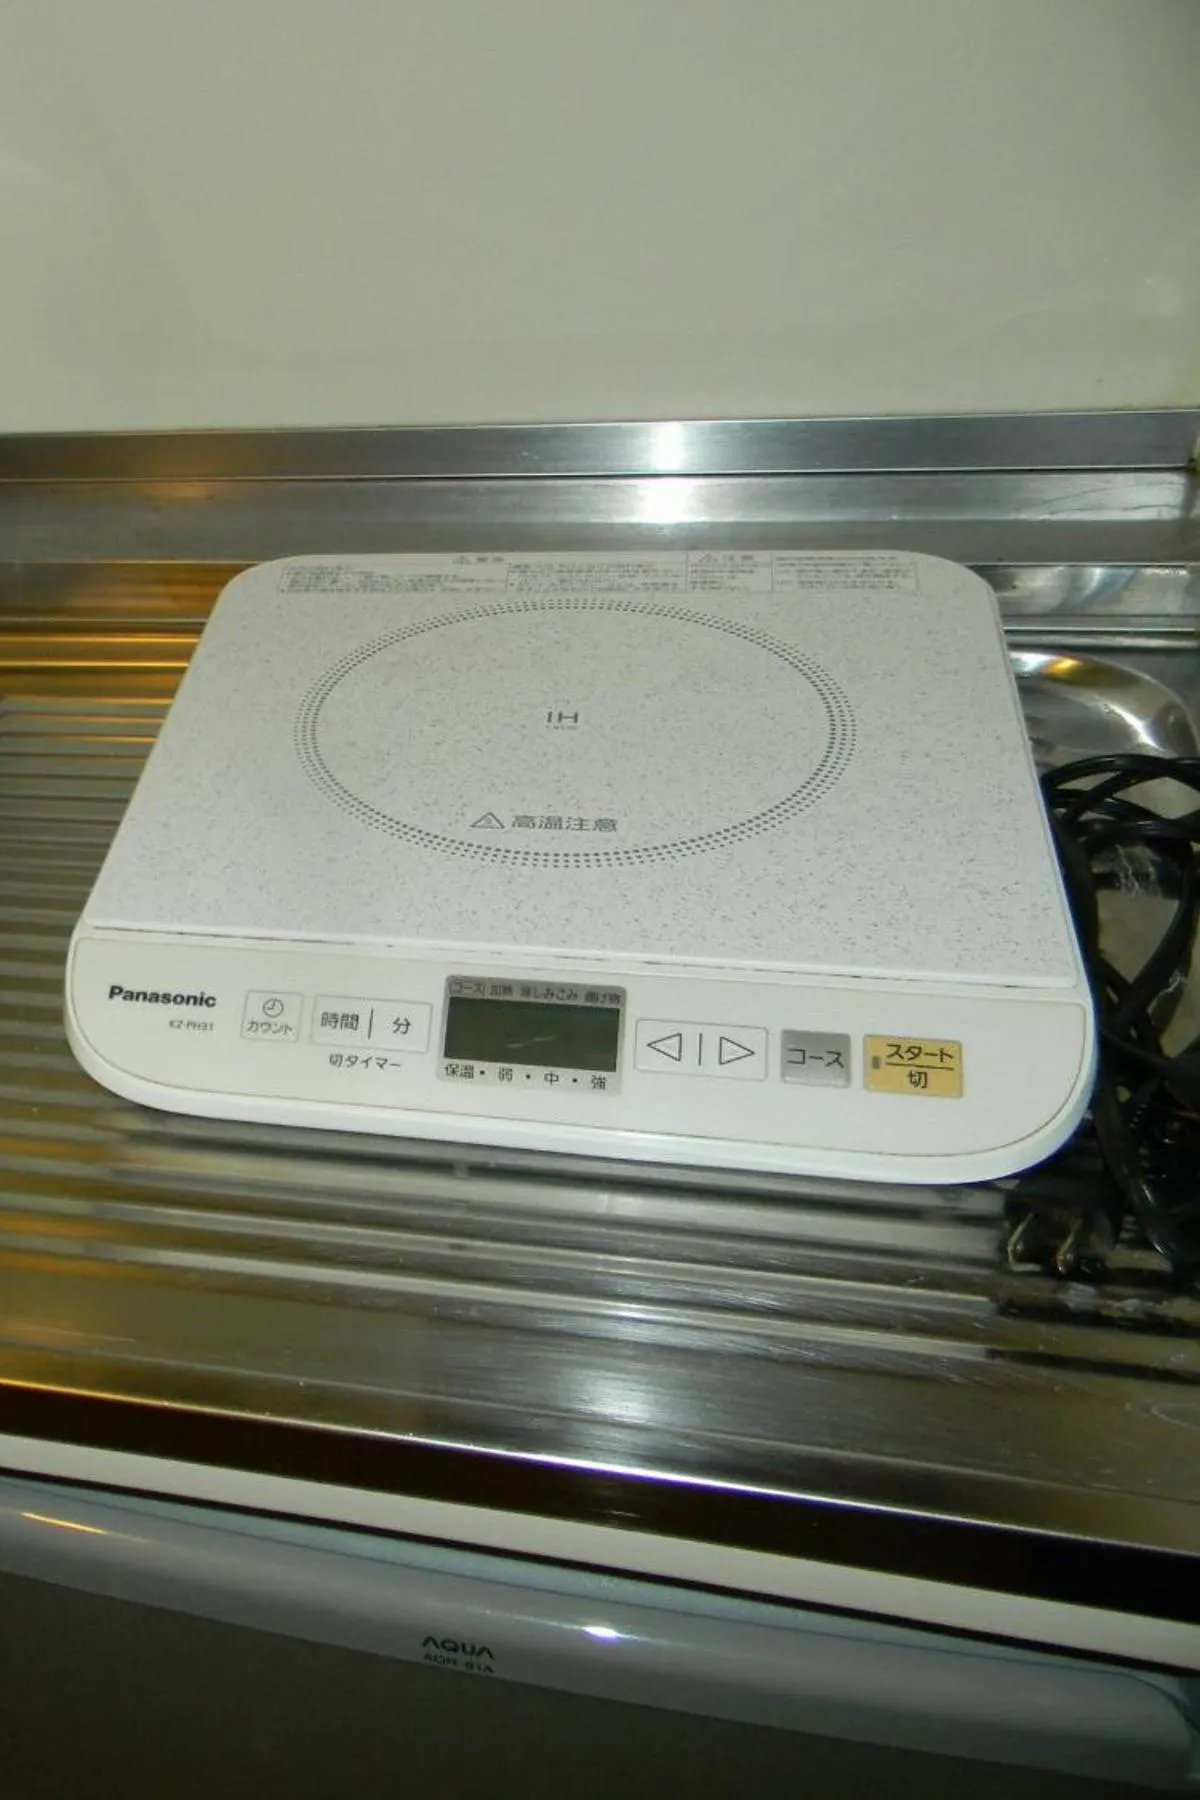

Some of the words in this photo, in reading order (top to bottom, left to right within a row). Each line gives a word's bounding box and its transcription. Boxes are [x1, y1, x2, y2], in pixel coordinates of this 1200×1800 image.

[547, 711, 579, 724] IH
[512, 815, 618, 833] 高温注意
[108, 984, 217, 1008] Panasonic
[246, 1021, 295, 1036] カウント
[320, 1011, 359, 1032] 時間
[392, 1016, 411, 1035] 分
[328, 1053, 401, 1070] 切タイマー
[786, 1048, 844, 1068] コース
[886, 1043, 954, 1063] スタート
[908, 1070, 928, 1089] 切
[422, 1635, 496, 1661] AQUA
